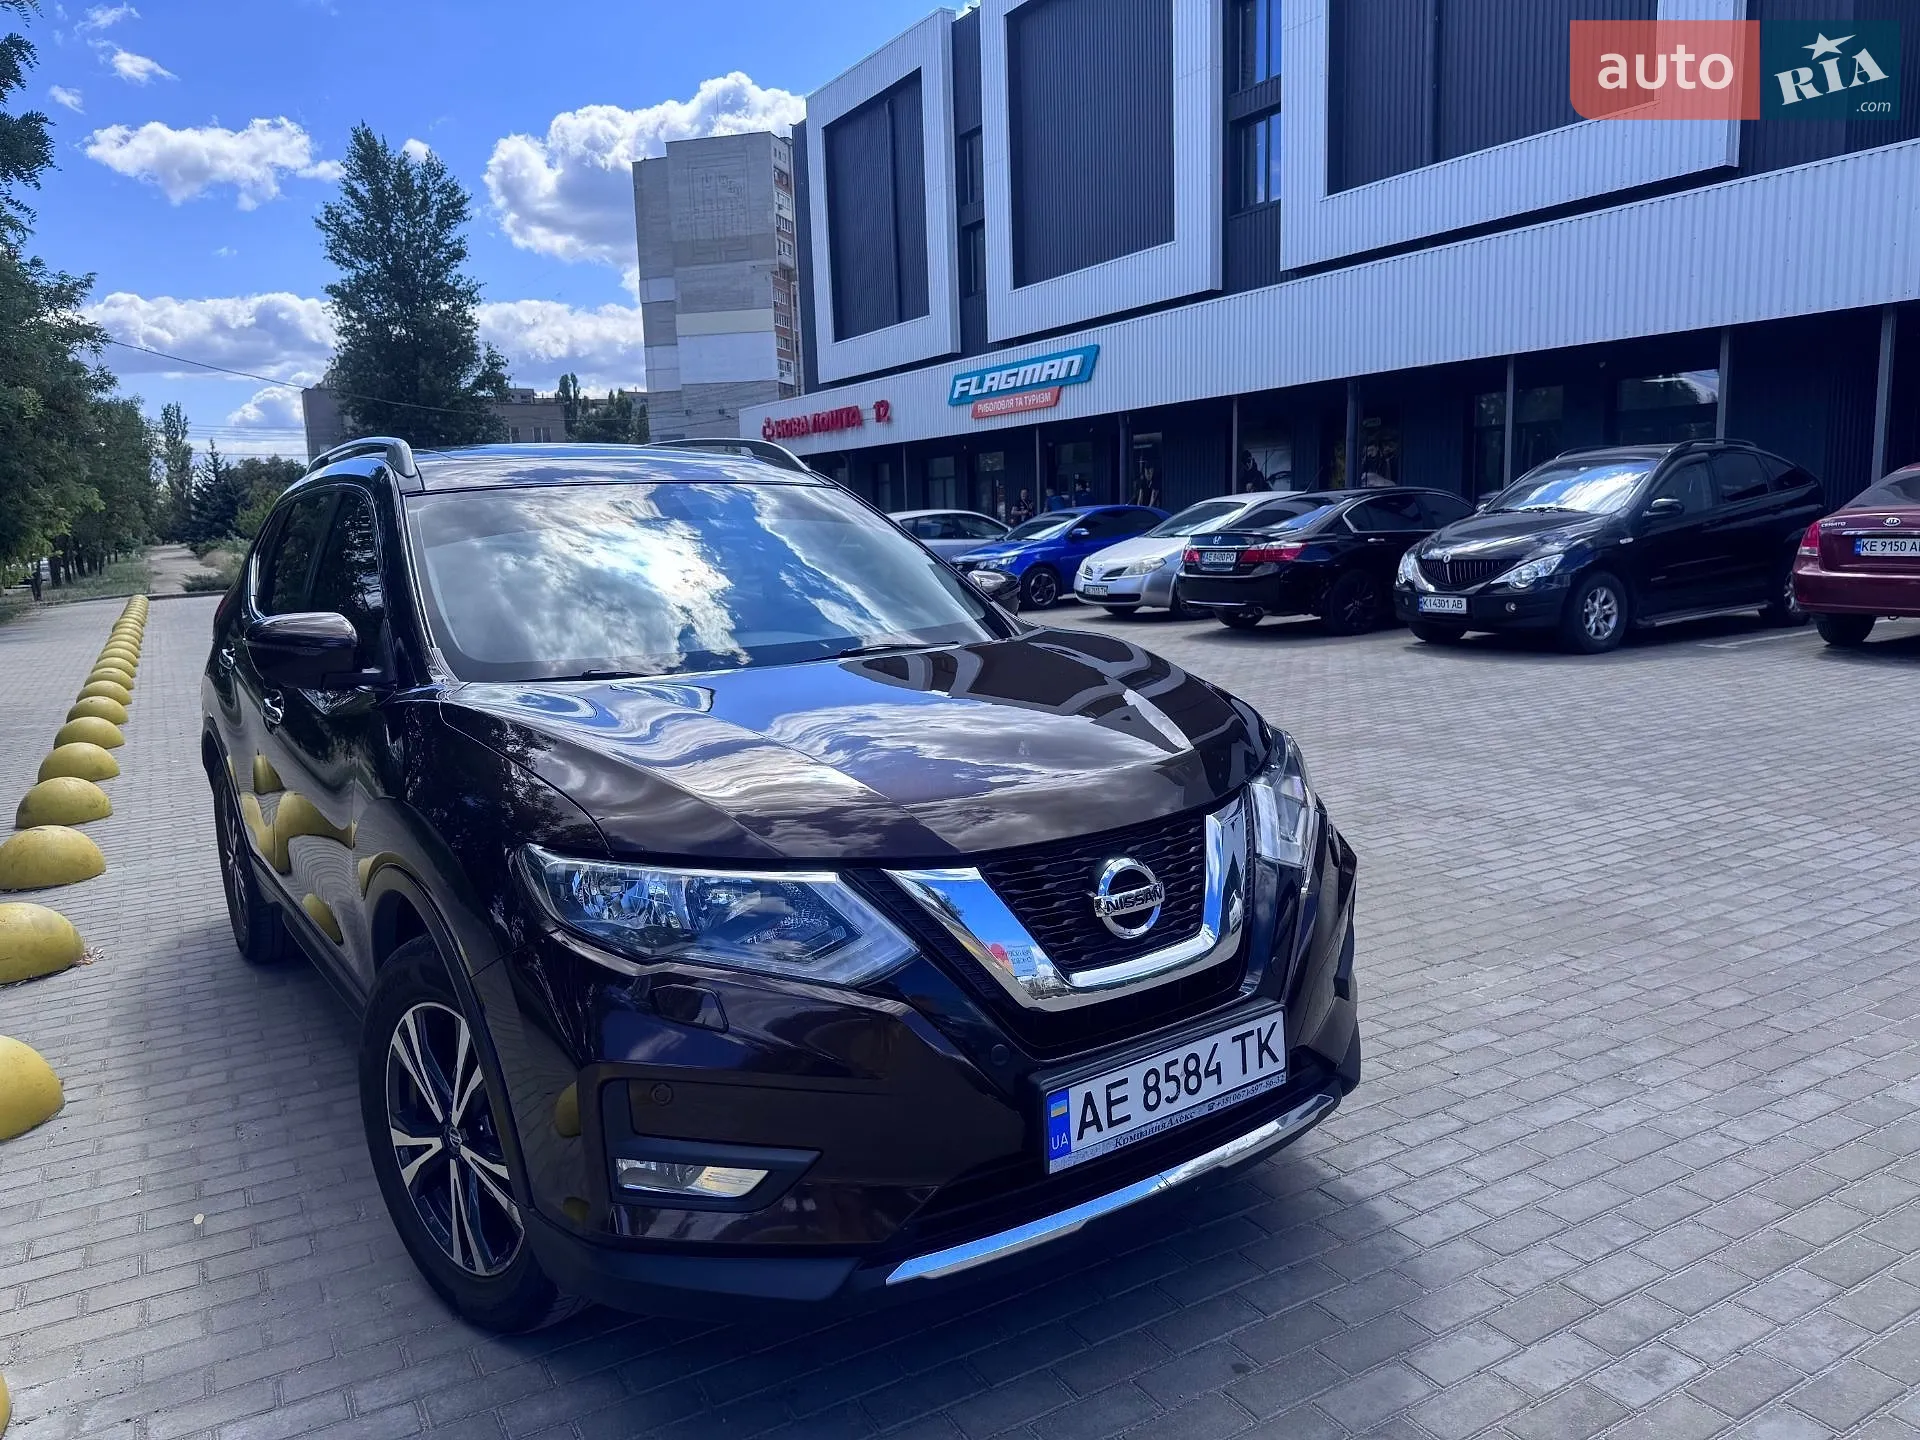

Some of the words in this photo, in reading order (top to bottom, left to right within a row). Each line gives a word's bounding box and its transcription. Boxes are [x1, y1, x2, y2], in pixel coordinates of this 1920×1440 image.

[953, 354, 1084, 399] FLAGMAN
[1024, 392, 1051, 406] ТУРИЗМ
[1862, 540, 1878, 552] KE
[1880, 540, 1907, 552] 9150
[1432, 598, 1450, 608] 4301
[1452, 599, 1463, 609] AB
[1106, 886, 1162, 912] NISSAN
[1077, 1077, 1132, 1141] AE
[1142, 1042, 1222, 1112] 8584
[1231, 1021, 1280, 1075] TK
[1051, 1138, 1069, 1151] UA
